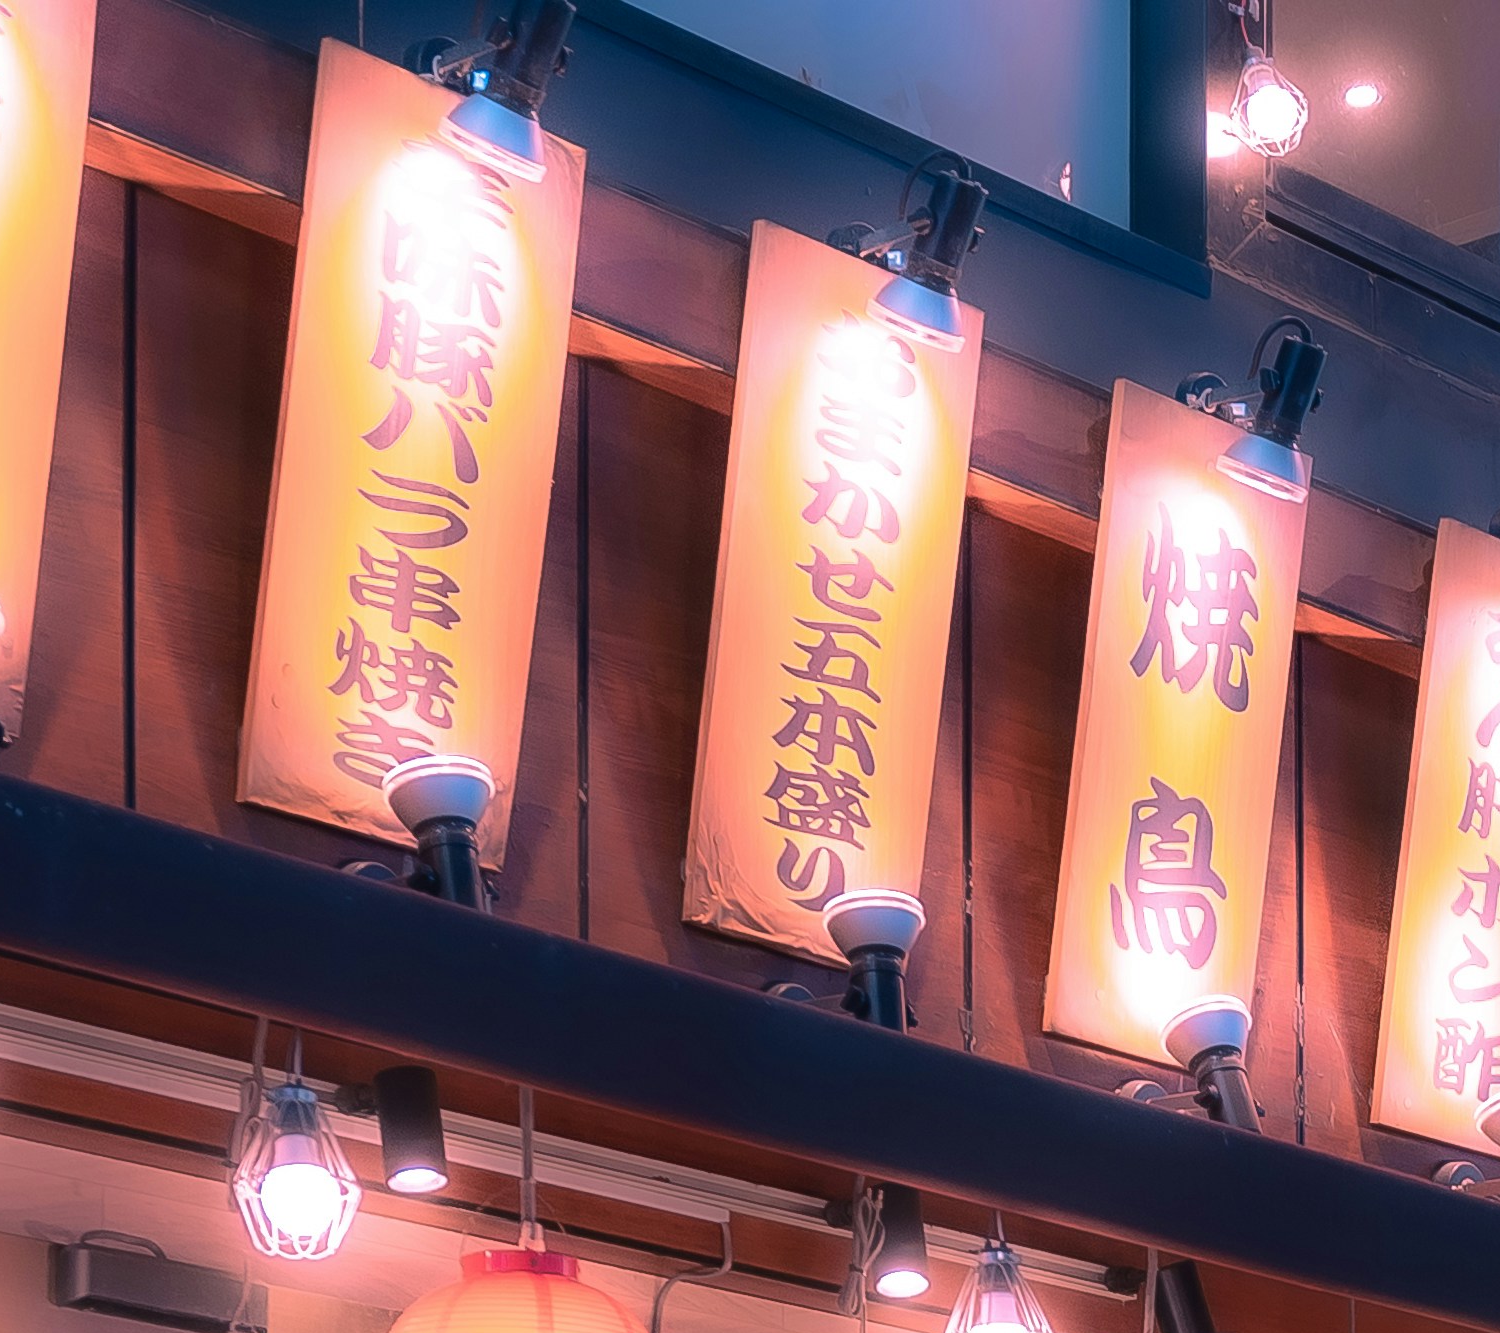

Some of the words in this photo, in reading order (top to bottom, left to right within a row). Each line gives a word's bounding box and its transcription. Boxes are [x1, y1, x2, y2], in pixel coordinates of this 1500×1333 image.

[328, 135, 514, 790] 味豚バラ串焼き
[1110, 501, 1260, 970] 焼鳥
